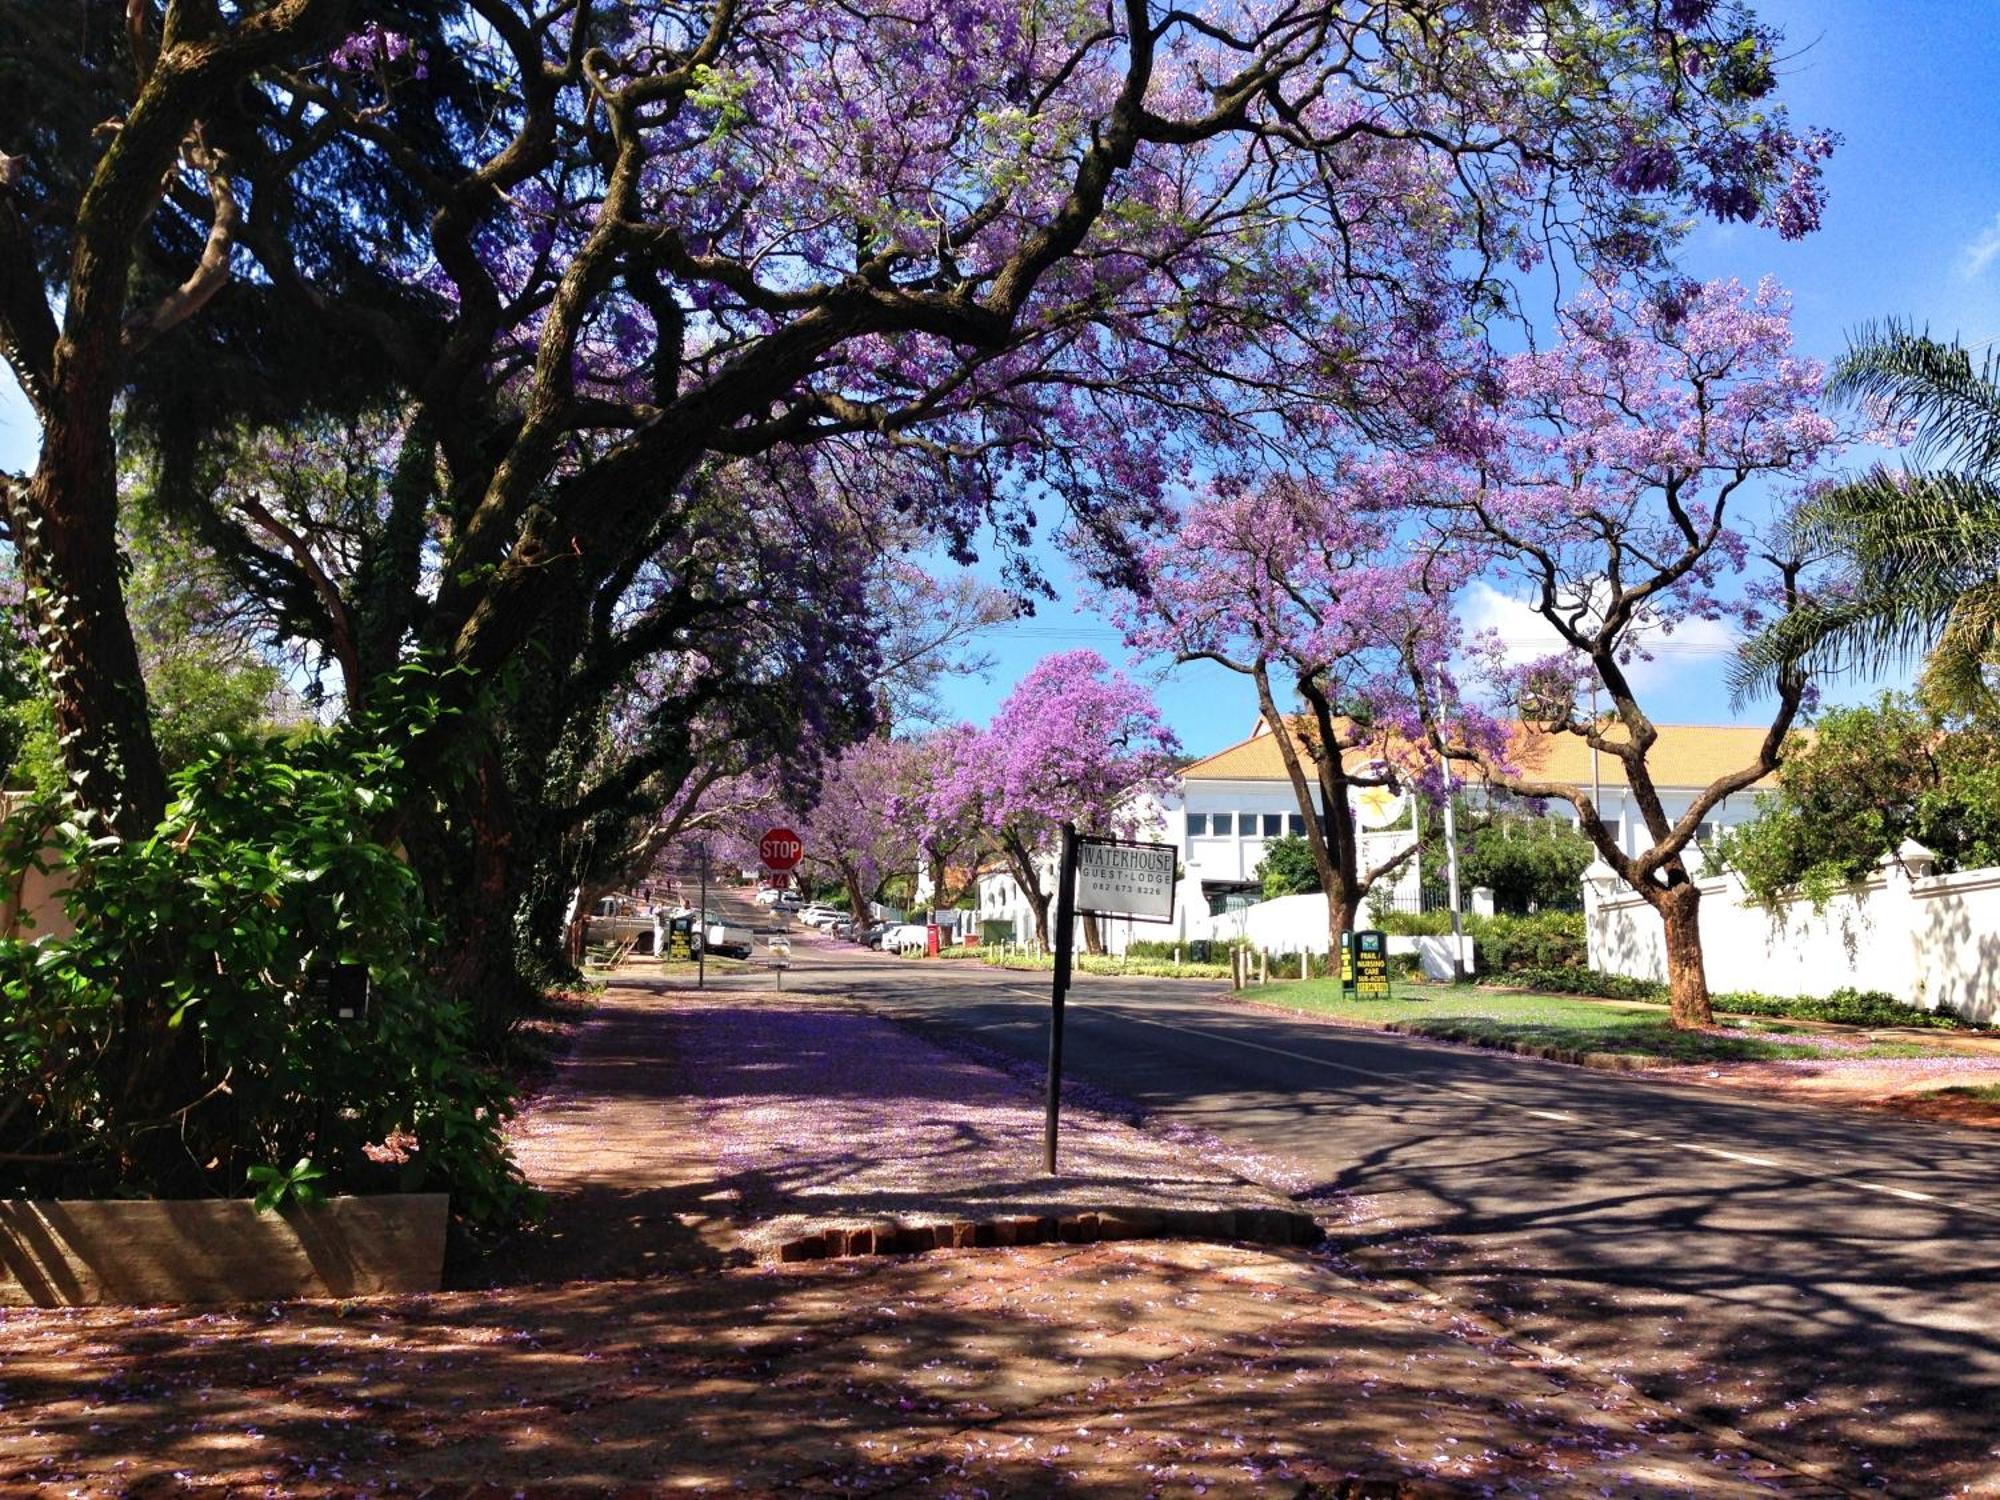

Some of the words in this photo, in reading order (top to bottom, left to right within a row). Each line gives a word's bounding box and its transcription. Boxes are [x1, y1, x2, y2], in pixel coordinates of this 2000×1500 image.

[762, 840, 799, 858] STOP
[1084, 847, 1172, 872] WATERHOUSE
[1092, 882, 1111, 892] 082
[1357, 960, 1385, 968] NURSING
[1364, 968, 1380, 976] CARE
